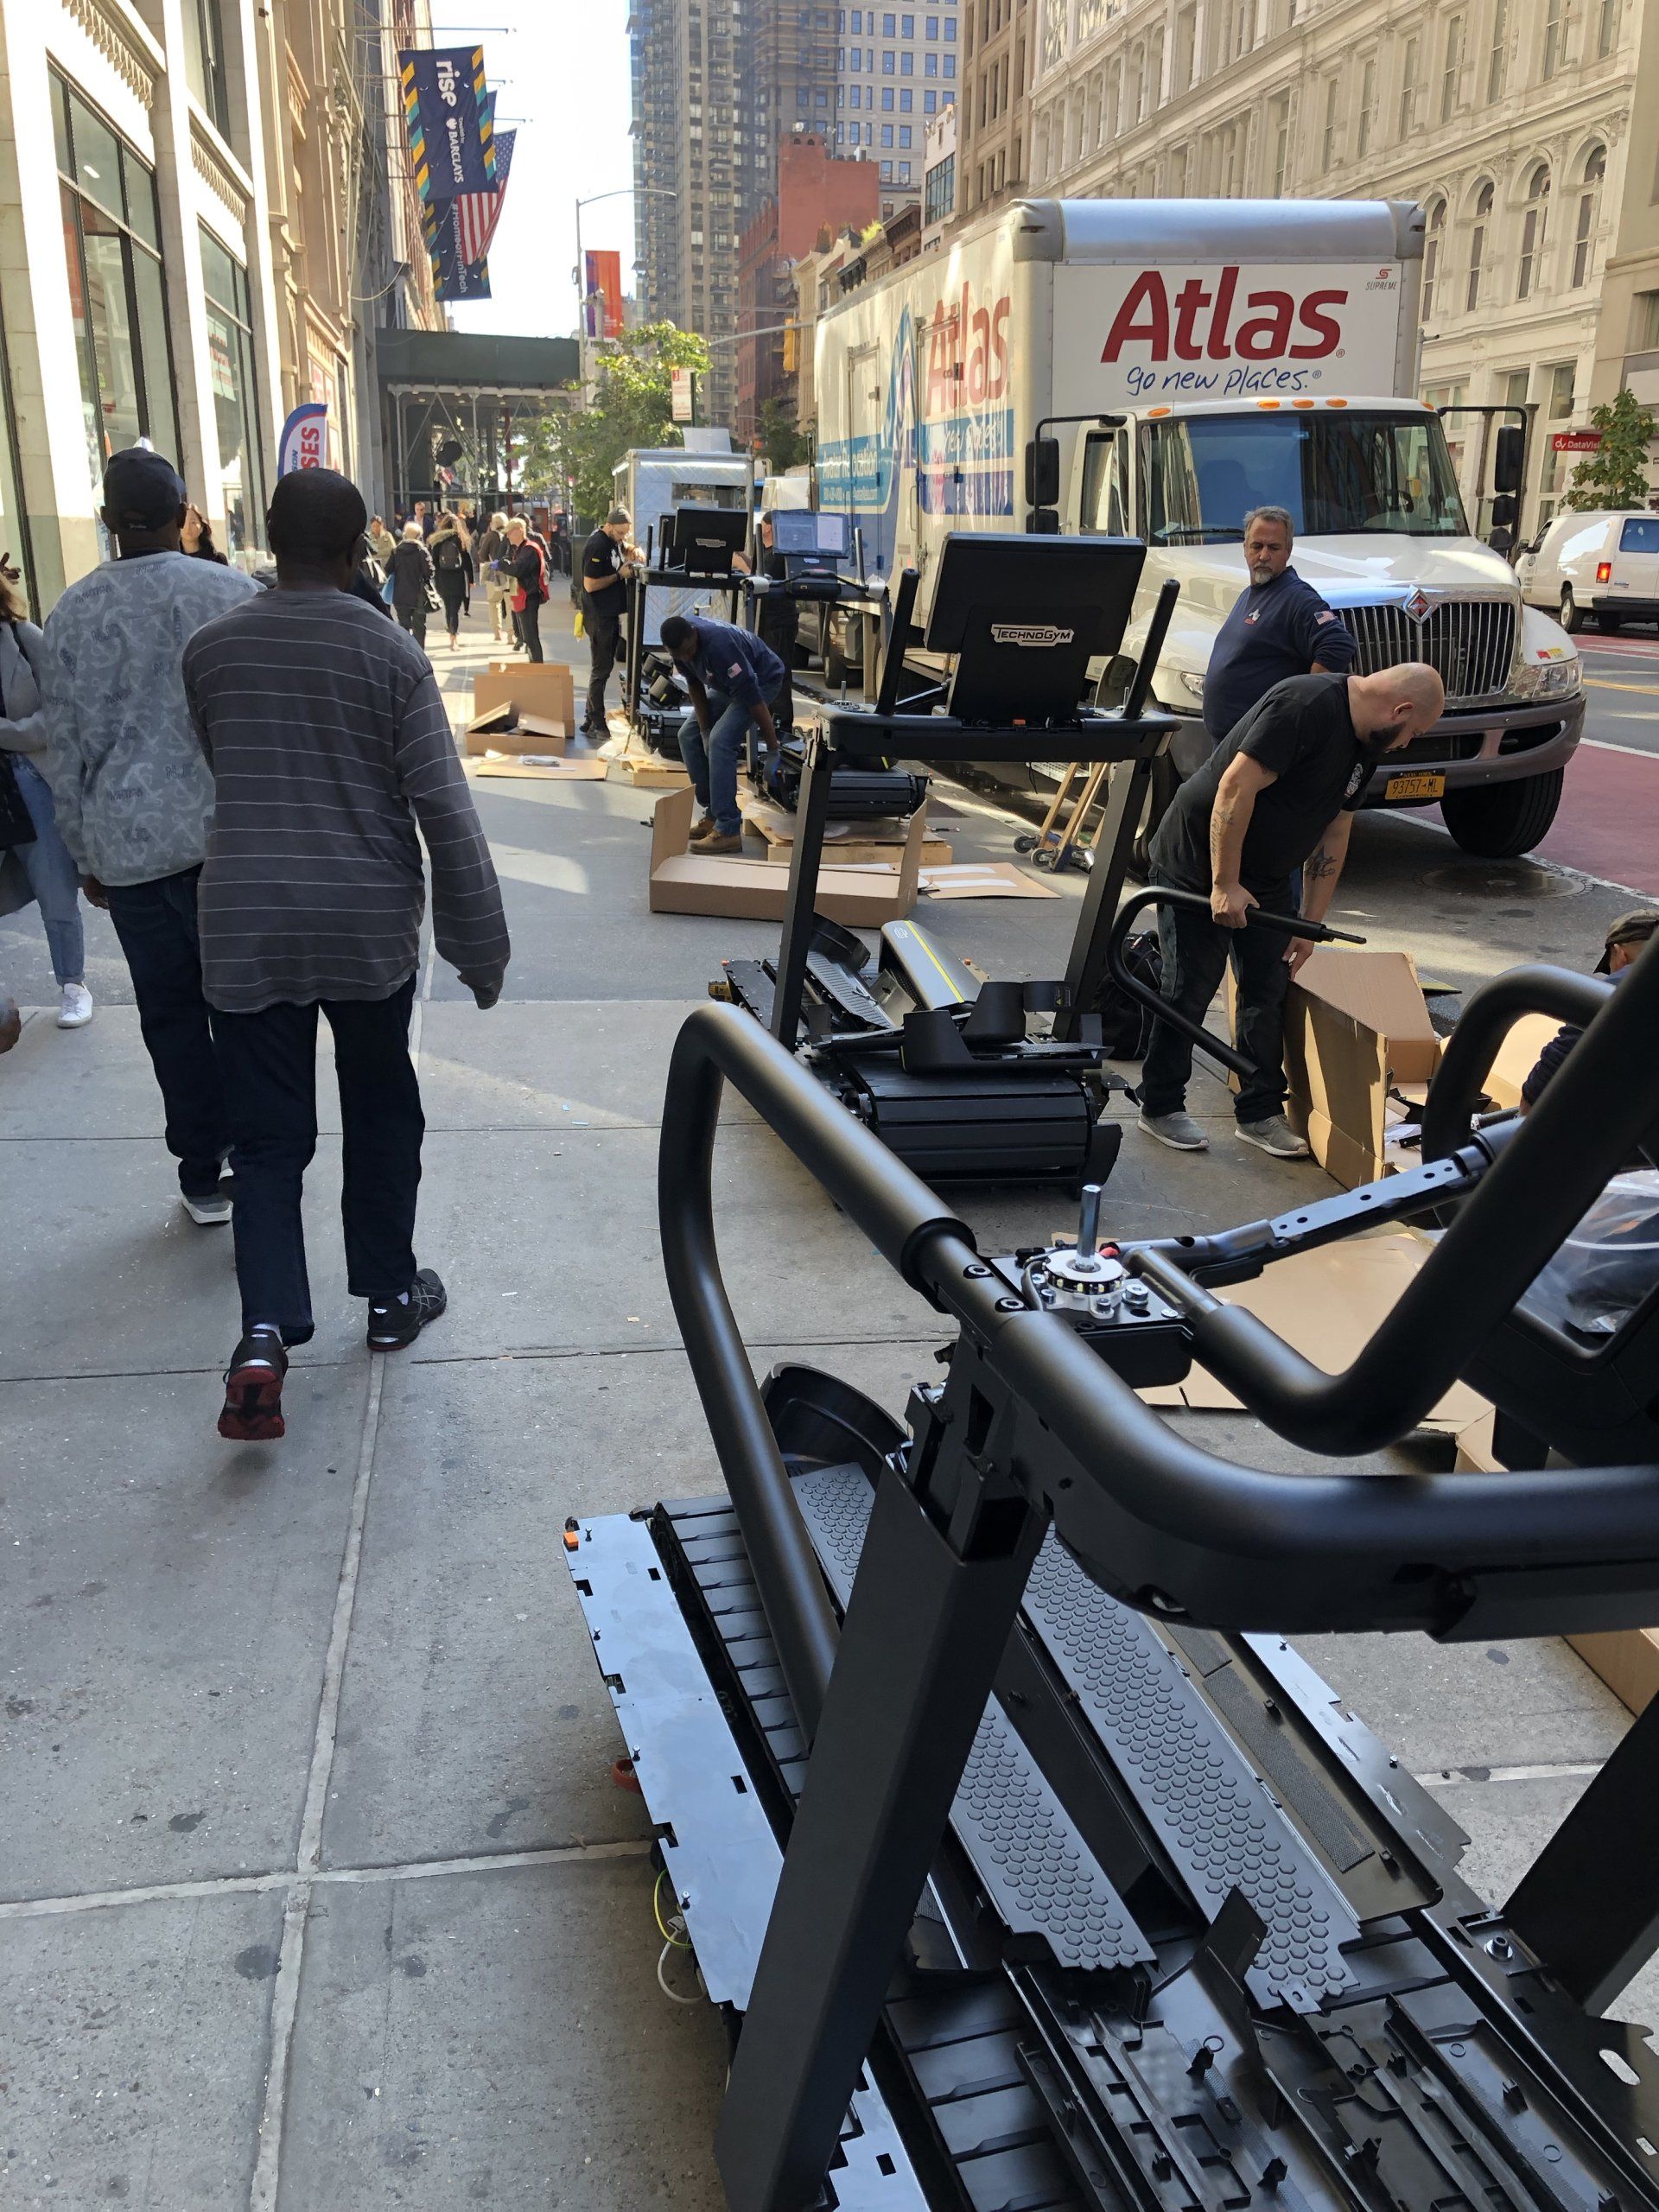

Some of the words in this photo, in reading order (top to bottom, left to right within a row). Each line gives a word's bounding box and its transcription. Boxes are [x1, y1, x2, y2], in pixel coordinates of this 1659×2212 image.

[436, 60, 460, 107] rise
[448, 131, 464, 183] BARCLAYS
[1365, 281, 1398, 291] SUPREME
[1100, 266, 1349, 363] Atlas
[925, 281, 1010, 418] Atlas
[1126, 366, 1155, 396] go
[1162, 370, 1217, 390] new
